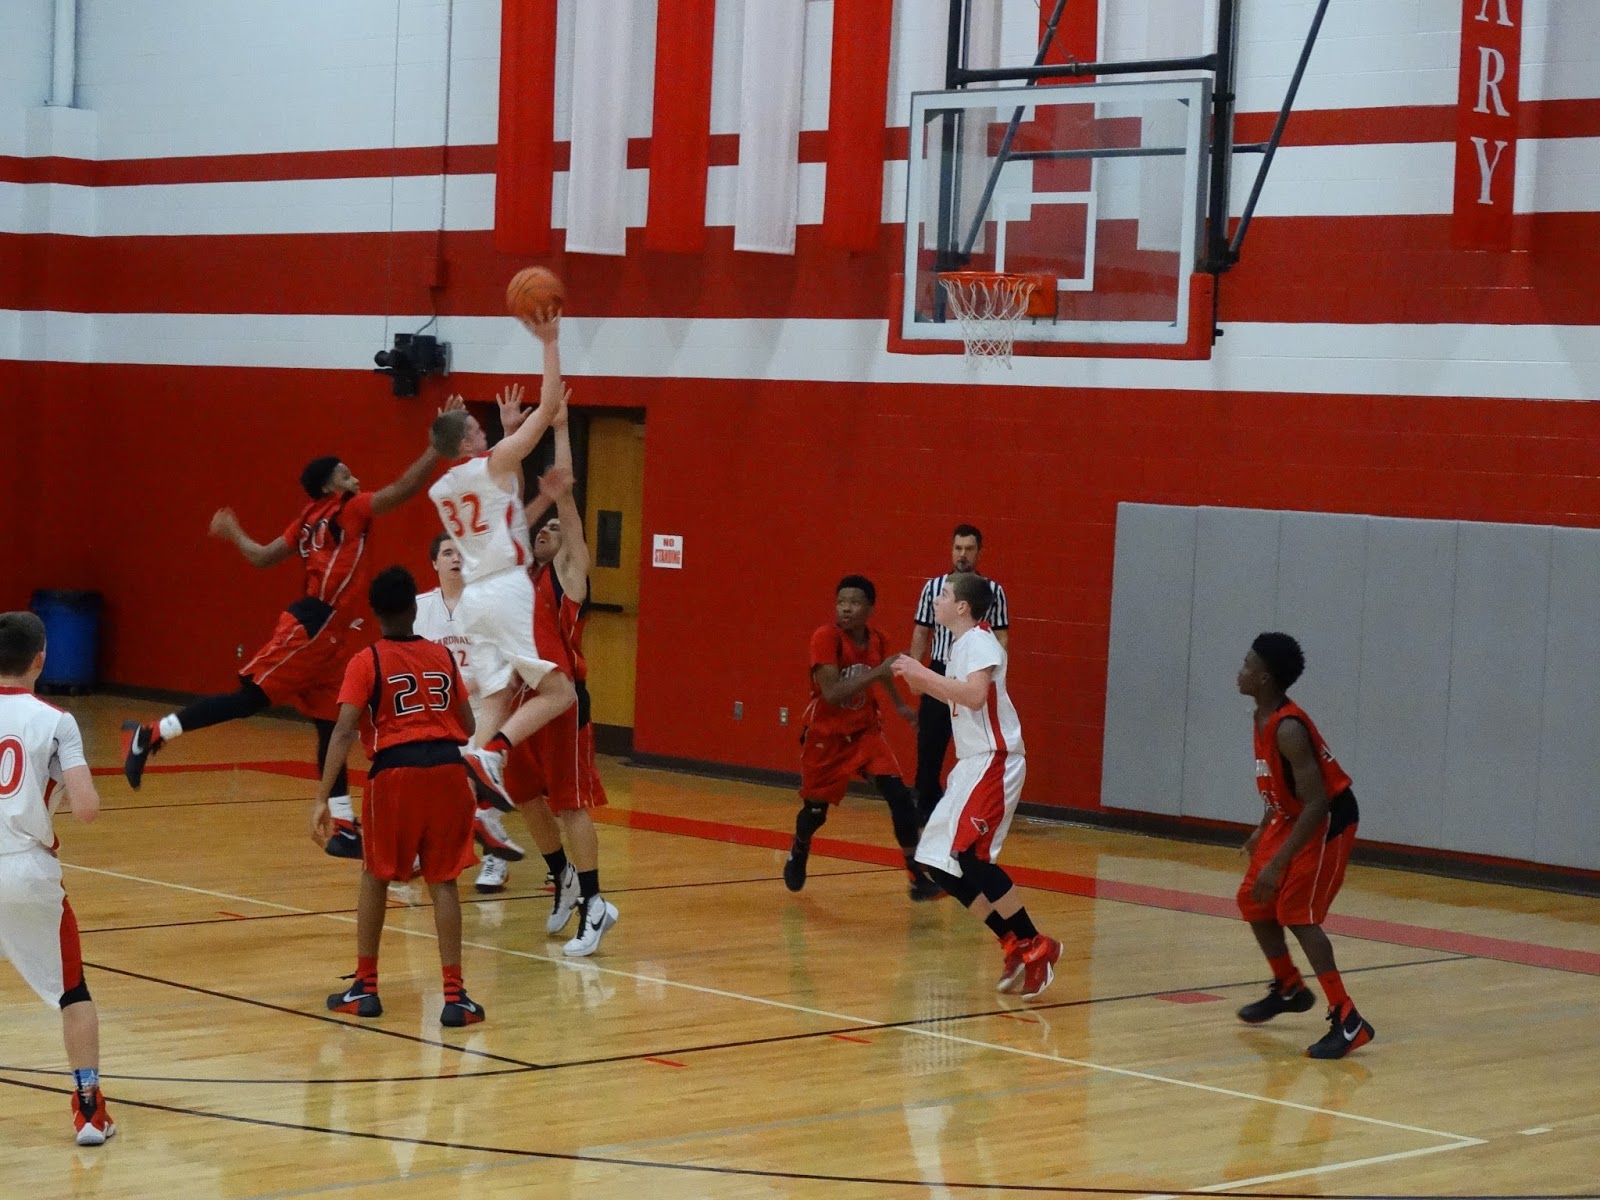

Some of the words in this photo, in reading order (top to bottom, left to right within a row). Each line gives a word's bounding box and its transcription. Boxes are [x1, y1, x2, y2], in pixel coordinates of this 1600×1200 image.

[442, 493, 489, 538] 32
[299, 518, 329, 558] 20
[663, 538, 675, 547] NO
[387, 671, 451, 716] 23
